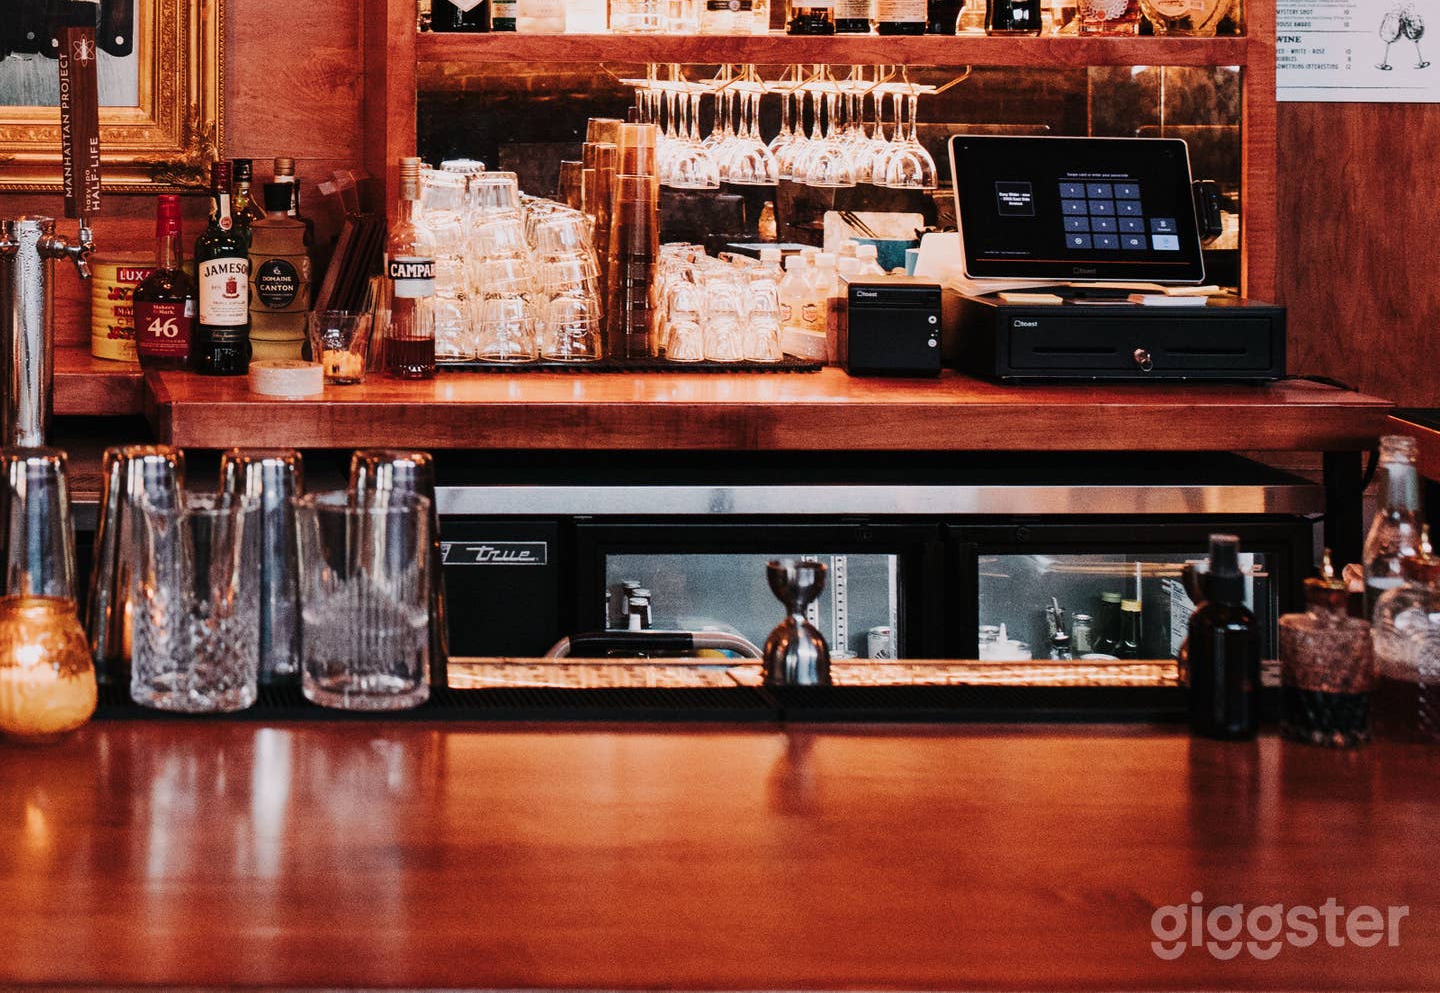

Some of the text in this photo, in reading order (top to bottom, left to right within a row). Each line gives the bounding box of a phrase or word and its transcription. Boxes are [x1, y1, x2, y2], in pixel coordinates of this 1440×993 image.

[60, 53, 73, 198] MANHATTAN PROJECT
[89, 136, 101, 211] HALF-LIFE
[260, 284, 294, 292] CANTON
[148, 317, 179, 338] 46
[466, 545, 535, 561] True
